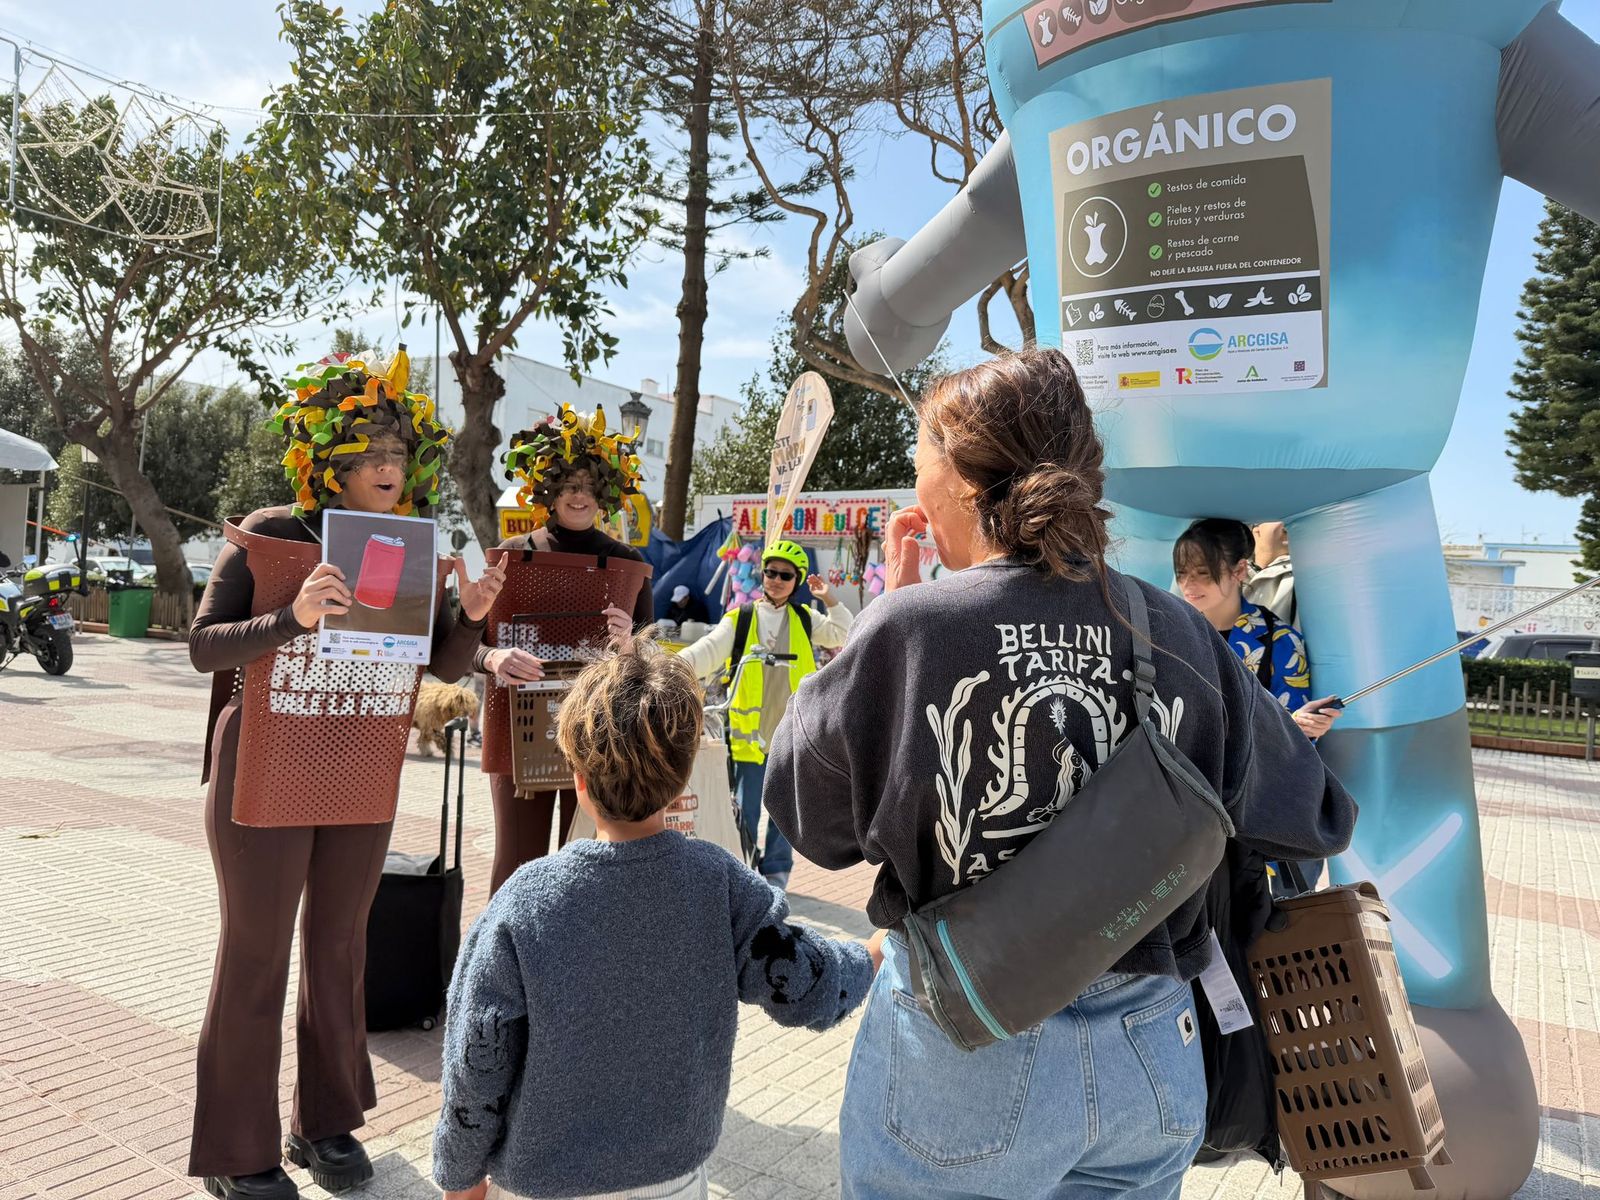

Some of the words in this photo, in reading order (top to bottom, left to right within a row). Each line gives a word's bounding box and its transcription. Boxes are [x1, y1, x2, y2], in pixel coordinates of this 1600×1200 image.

[1066, 104, 1297, 176] ORGÁNICO
[1196, 178, 1208, 189] de
[1211, 173, 1247, 188] comida
[1167, 203, 1192, 215] Pieles
[1195, 204, 1201, 214] y
[1203, 200, 1231, 211] restos
[1234, 197, 1247, 208] de
[1167, 214, 1192, 227] frutas
[1195, 216, 1201, 226] y
[1203, 210, 1246, 223] verduras
[1167, 237, 1195, 249] Restos
[1197, 235, 1210, 246] de
[1212, 234, 1240, 245] carne
[1167, 253, 1173, 261] y
[1175, 246, 1214, 261] pescado
[1150, 269, 1161, 277] NO
[1162, 268, 1176, 276] DEJE
[1177, 267, 1186, 275] LA
[1187, 264, 1214, 273] BASURA
[1215, 262, 1238, 271] FUERA
[1239, 260, 1252, 269] DEL
[1253, 257, 1302, 269] CONTENEDOR
[1110, 342, 1121, 350] más
[1122, 339, 1160, 349] información,
[1227, 332, 1288, 348] ARCGISA
[1118, 350, 1130, 358] web
[1131, 346, 1178, 357] www.arcgisaes
[823, 507, 880, 531] DULCE
[995, 623, 1112, 656] BELLINI
[999, 650, 1118, 685] TARIFA
[270, 691, 324, 714] VALE
[327, 693, 357, 716] LA
